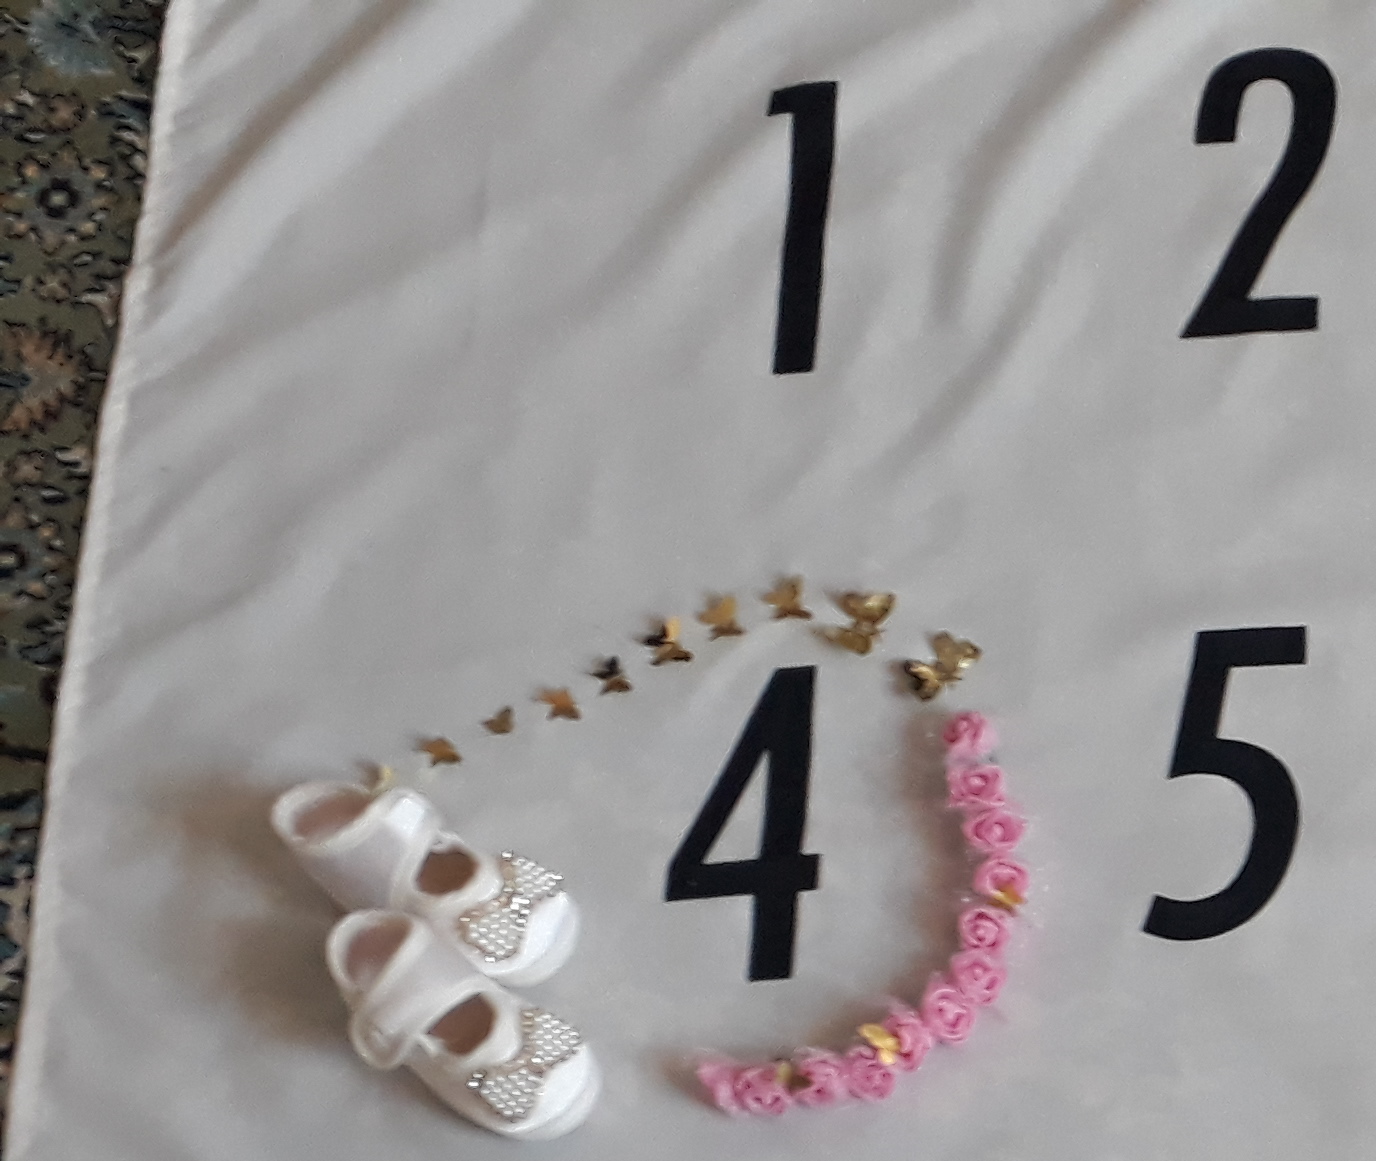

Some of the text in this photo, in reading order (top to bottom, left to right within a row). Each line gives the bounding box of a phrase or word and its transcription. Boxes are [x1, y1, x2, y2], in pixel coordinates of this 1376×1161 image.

[765, 80, 838, 376] 1
[1179, 47, 1338, 339] 2
[664, 665, 821, 983] 4
[1142, 625, 1308, 942] 5
